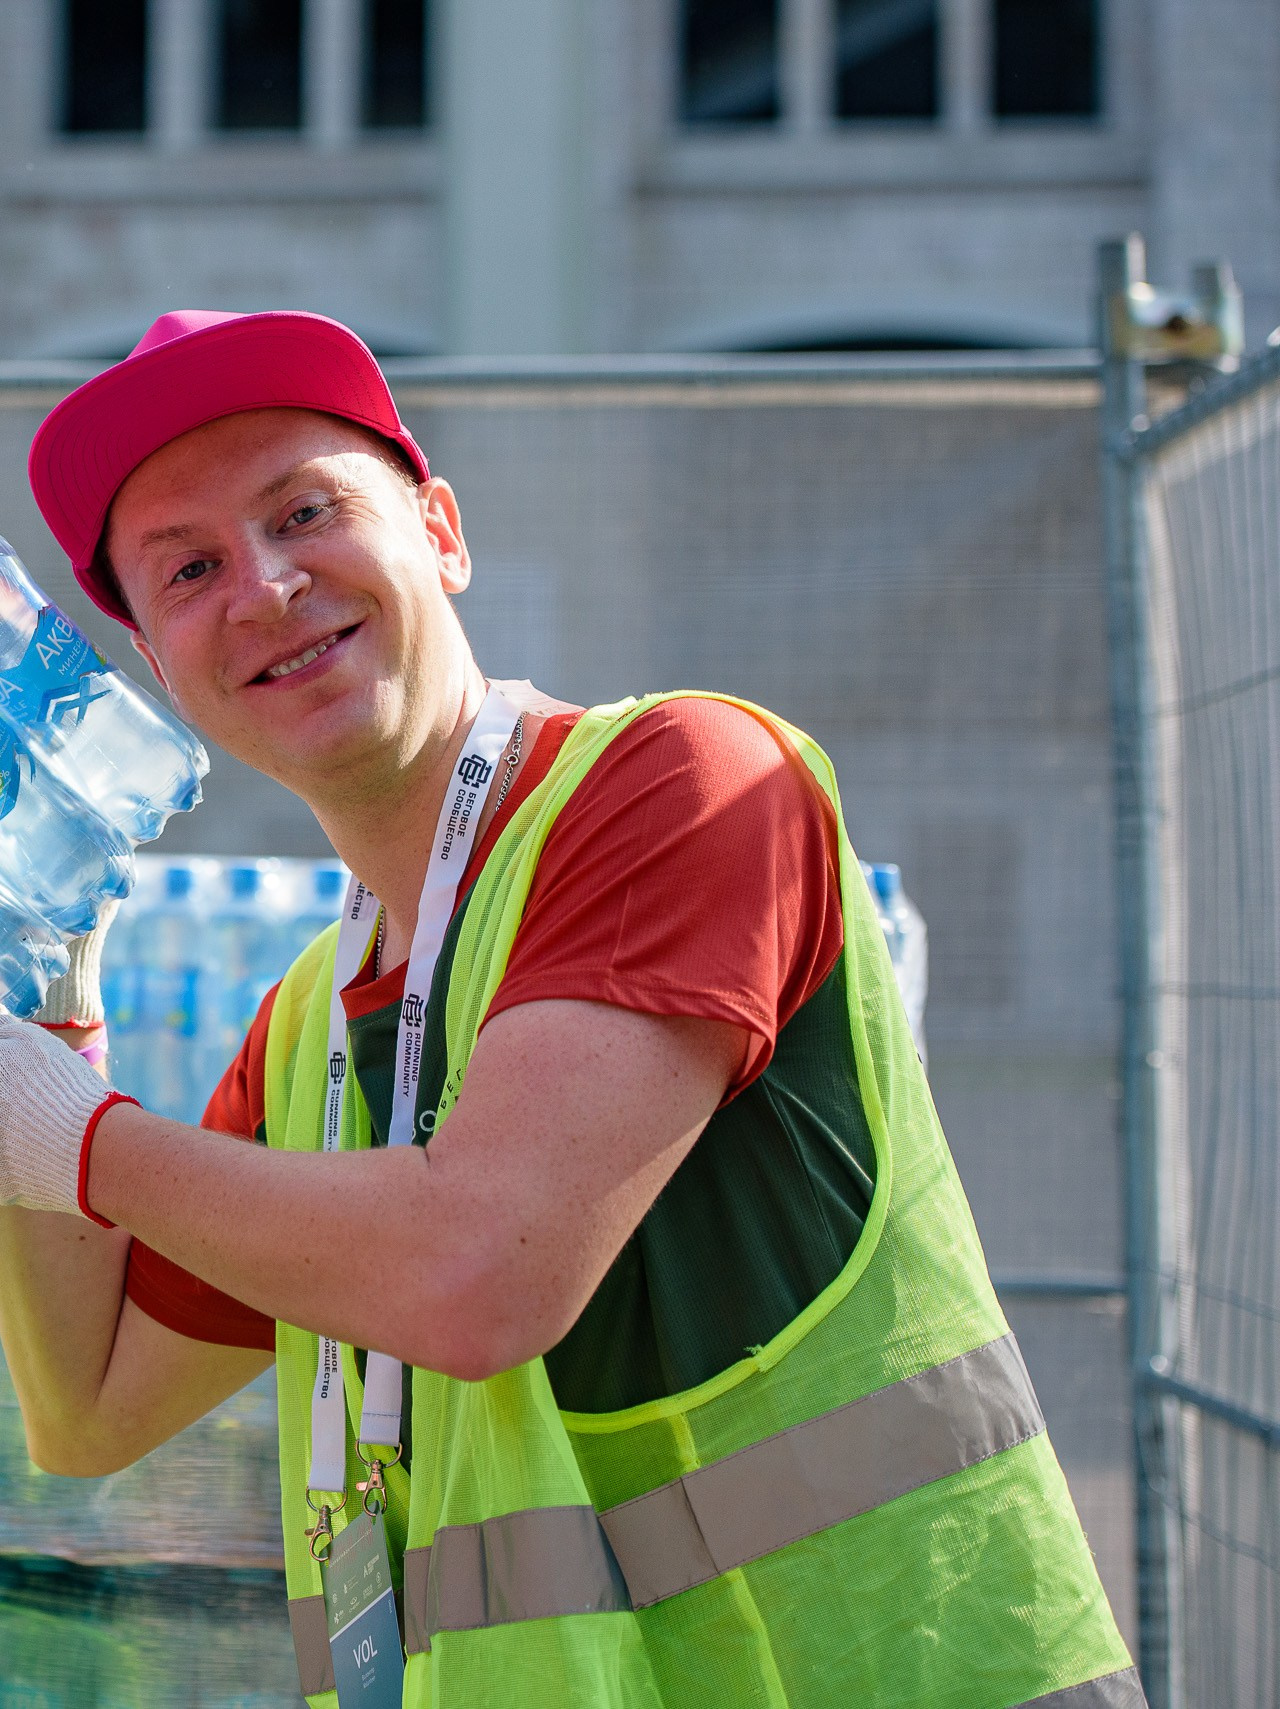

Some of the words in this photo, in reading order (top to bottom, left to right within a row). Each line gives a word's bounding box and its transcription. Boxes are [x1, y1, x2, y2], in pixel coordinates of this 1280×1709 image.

[36, 616, 75, 670] АКВ
[440, 788, 466, 860] СООБЩЕСТВО
[457, 791, 477, 838] БЕГОВОЕ
[351, 882, 365, 920] ЩЕСТВО
[403, 1032, 413, 1097] COMMUNITY
[412, 1032, 421, 1082] RUNNING
[328, 1089, 336, 1152] COMMUNITY
[320, 1336, 331, 1399] ООБЩЕСТВО
[353, 1635, 378, 1669] VOL
